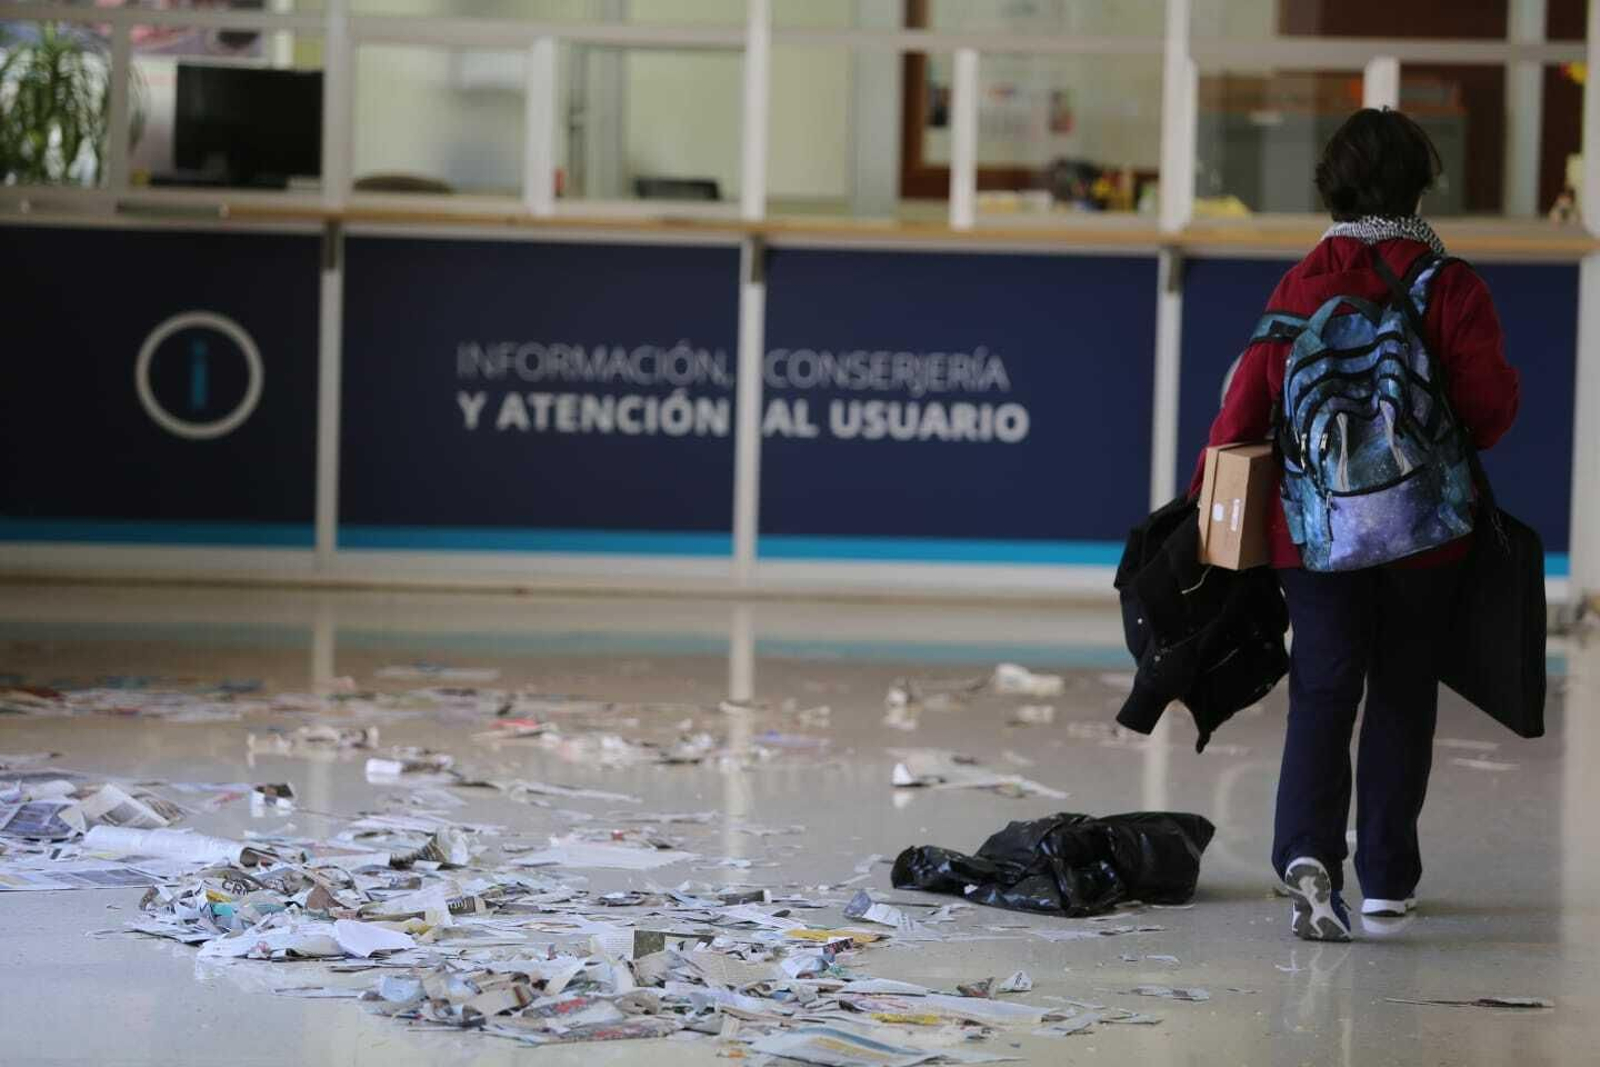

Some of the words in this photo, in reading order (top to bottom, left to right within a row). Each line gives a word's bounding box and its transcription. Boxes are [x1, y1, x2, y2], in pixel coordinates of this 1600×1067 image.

[763, 347, 1011, 397] CONSERJERÍA
[457, 391, 487, 430] Y
[496, 389, 730, 437] ATENCIÓN
[762, 399, 820, 438] AL
[829, 401, 1030, 443] USUARIO
